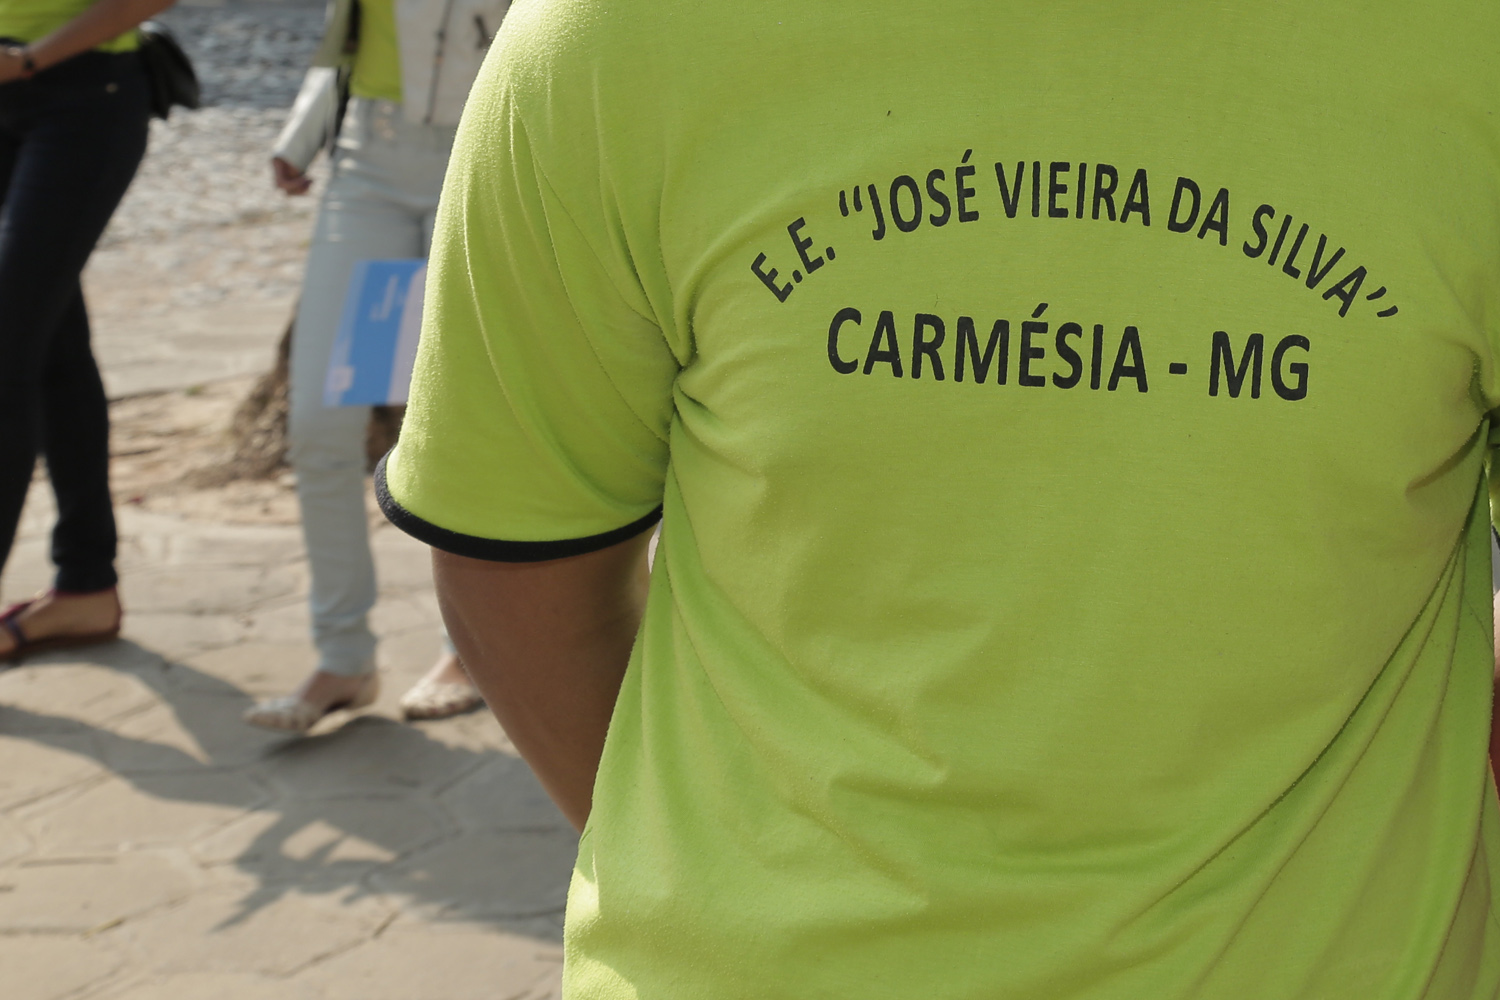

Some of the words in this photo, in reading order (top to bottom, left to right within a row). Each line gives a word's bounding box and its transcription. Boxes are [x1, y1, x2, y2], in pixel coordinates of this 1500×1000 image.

[750, 216, 836, 303] E.E.
[995, 161, 1151, 227] VIEIRA
[1168, 177, 1230, 247] DA
[828, 303, 1149, 394] CARMÉSIA
[1169, 362, 1188, 375] -
[1209, 331, 1311, 401] MG
